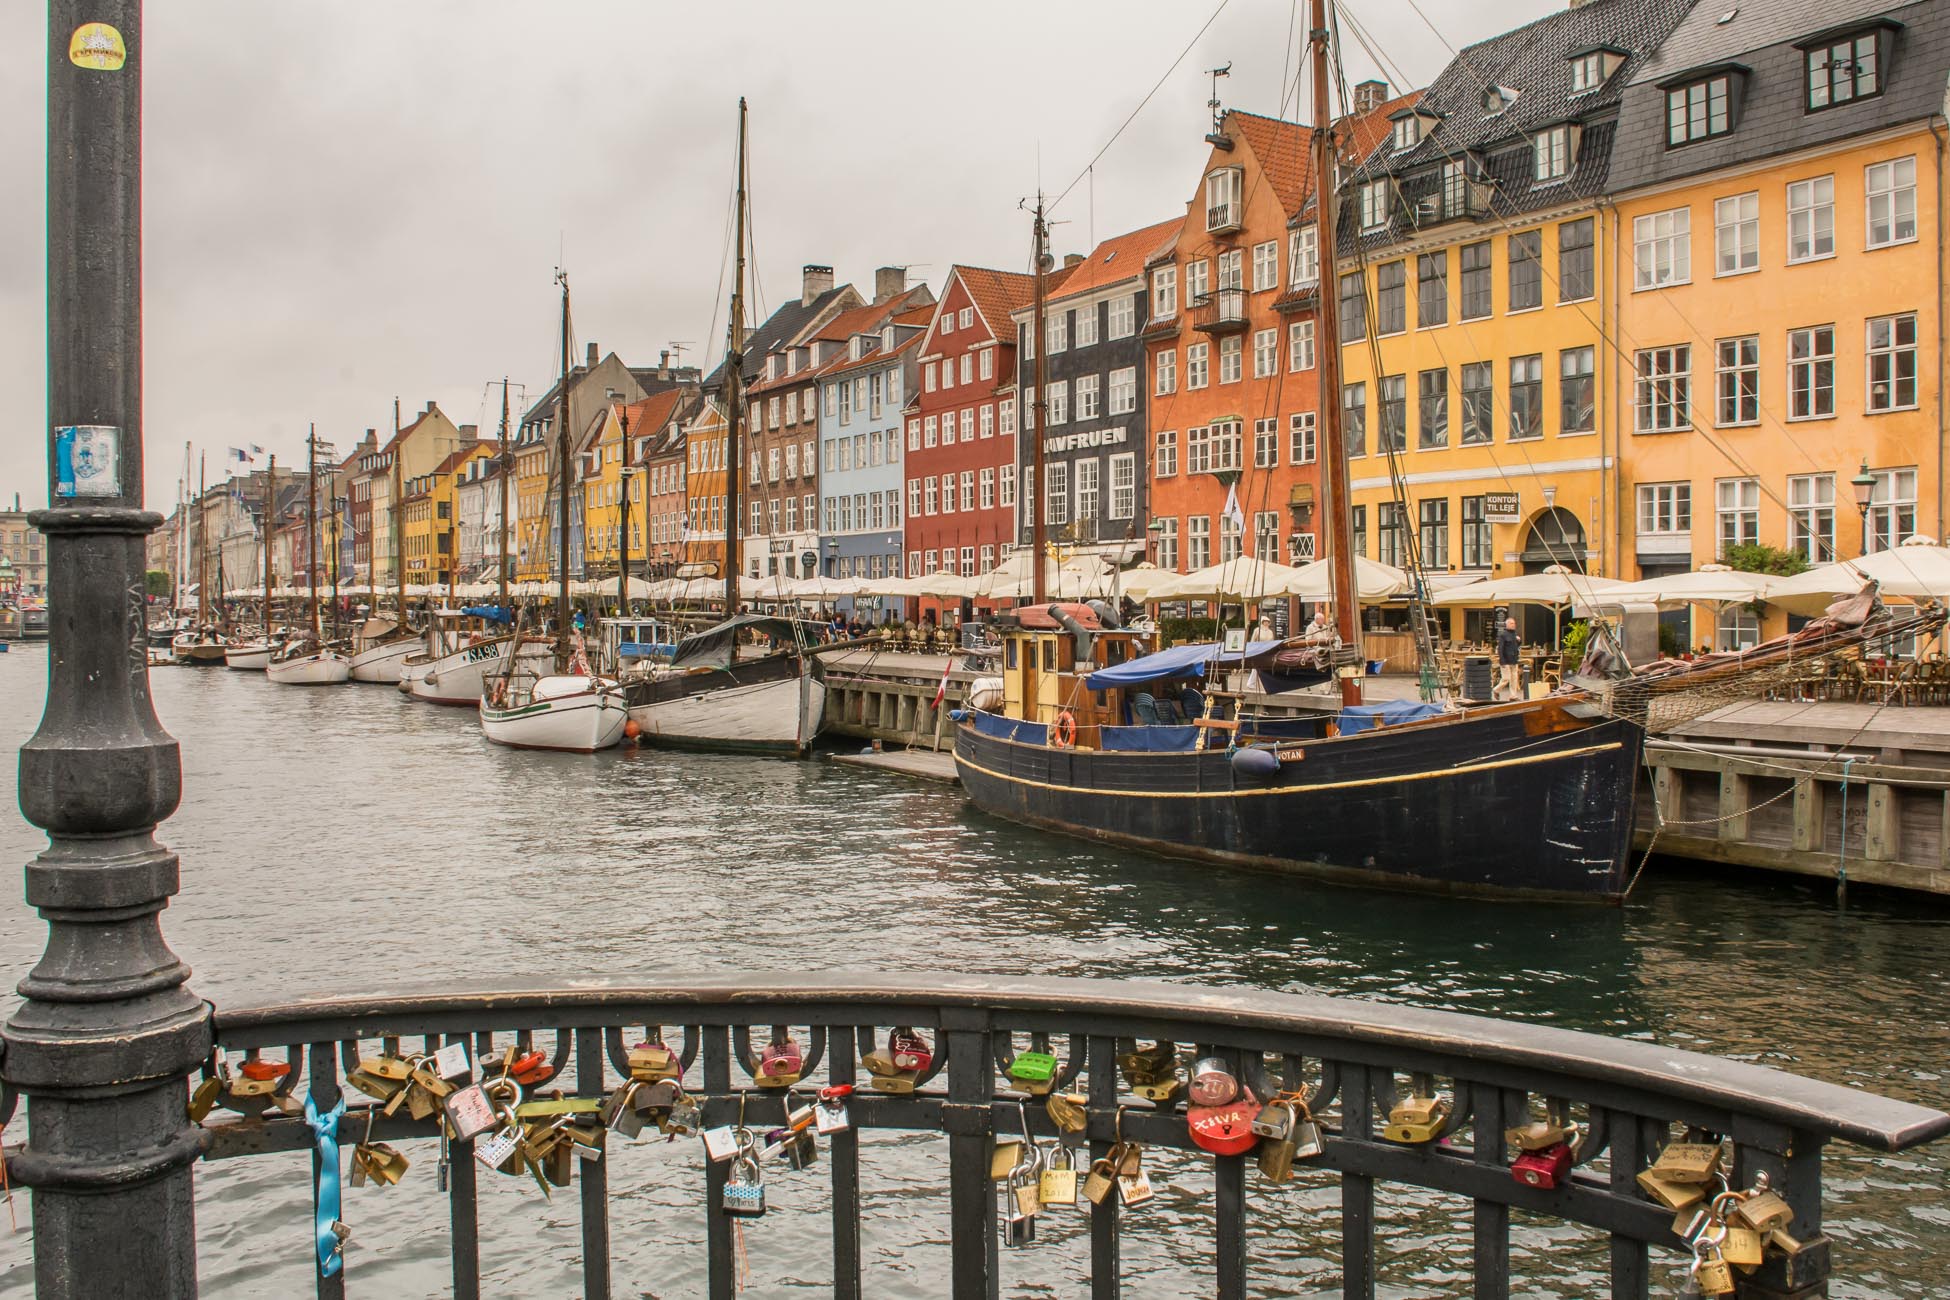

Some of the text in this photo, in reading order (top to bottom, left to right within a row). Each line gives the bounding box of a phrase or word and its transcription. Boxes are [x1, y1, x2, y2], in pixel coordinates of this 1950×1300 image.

[1487, 495, 1517, 503] KONTOR
[1500, 504, 1515, 512] LEJE
[1279, 751, 1302, 760] OTAN
